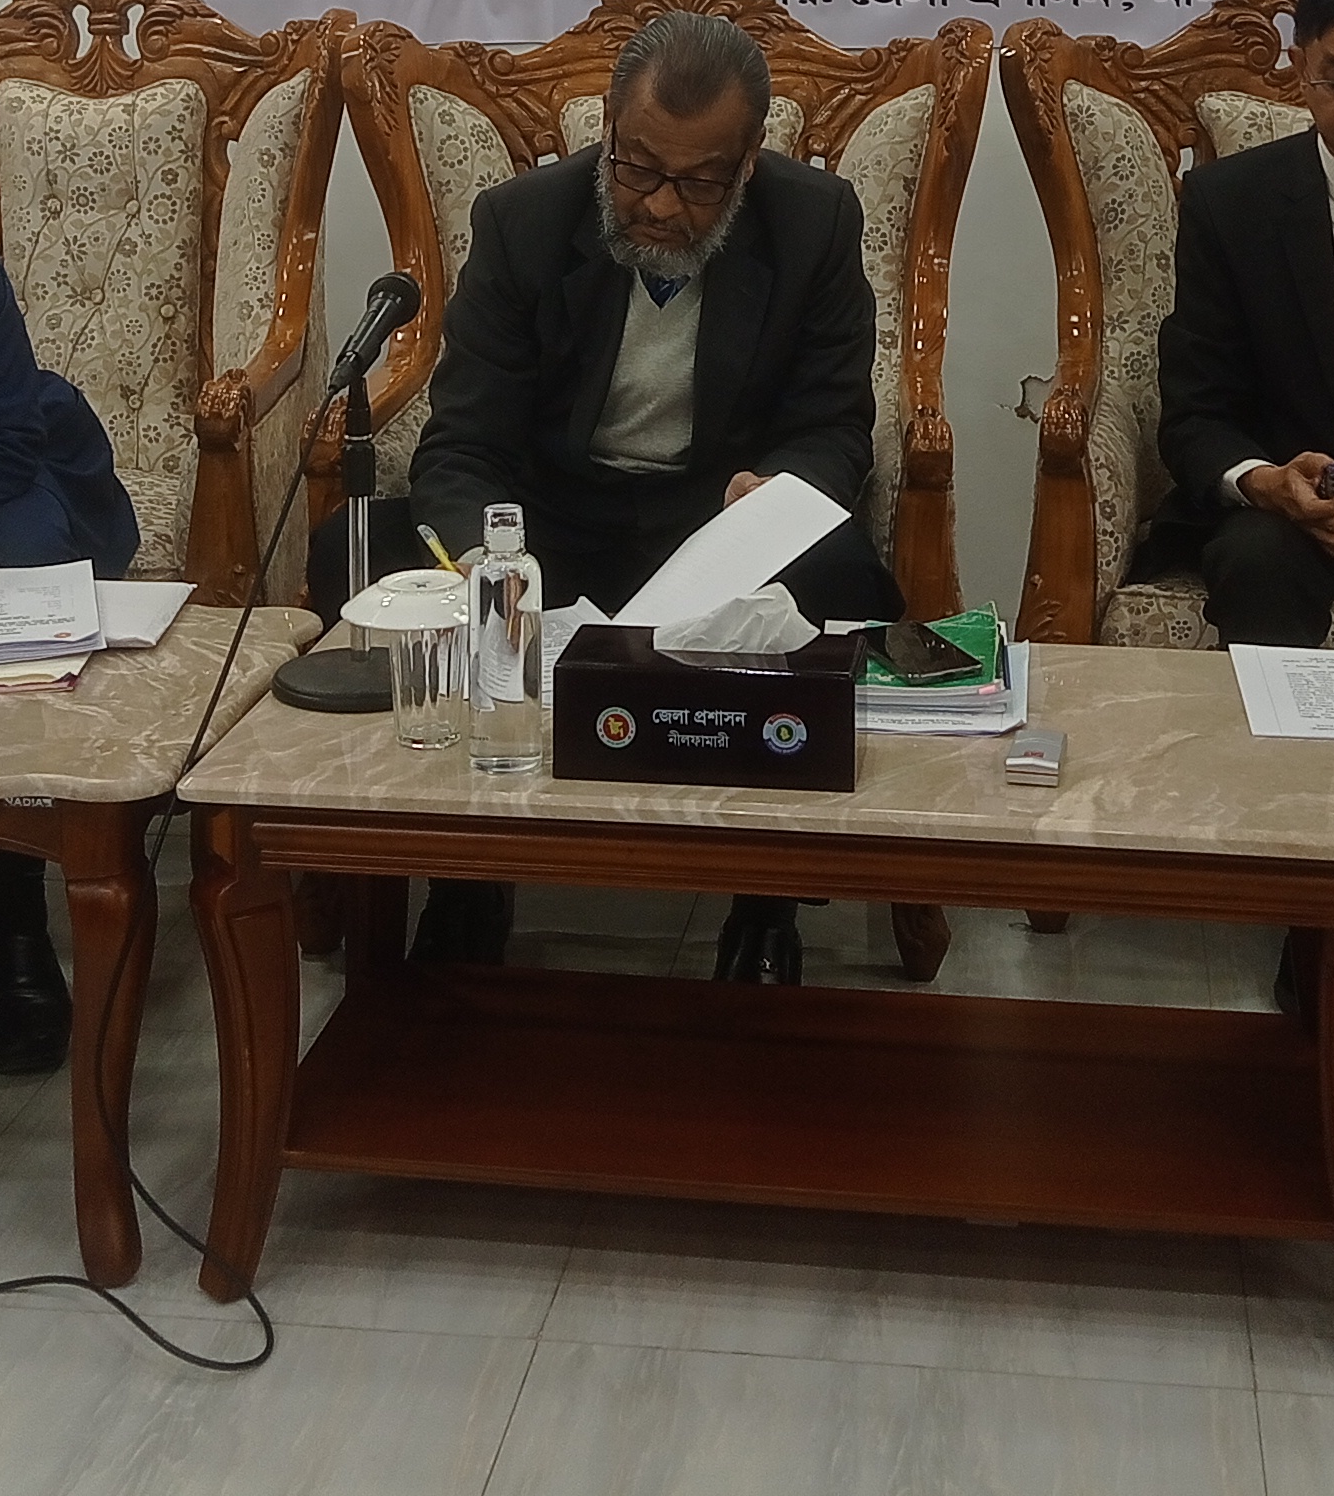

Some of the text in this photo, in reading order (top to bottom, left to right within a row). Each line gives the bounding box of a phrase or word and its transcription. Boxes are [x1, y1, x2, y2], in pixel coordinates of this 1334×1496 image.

[652, 707, 690, 726] জেলা
[693, 708, 748, 728] প্রশাসন
[667, 730, 731, 749] নীলফামারী
